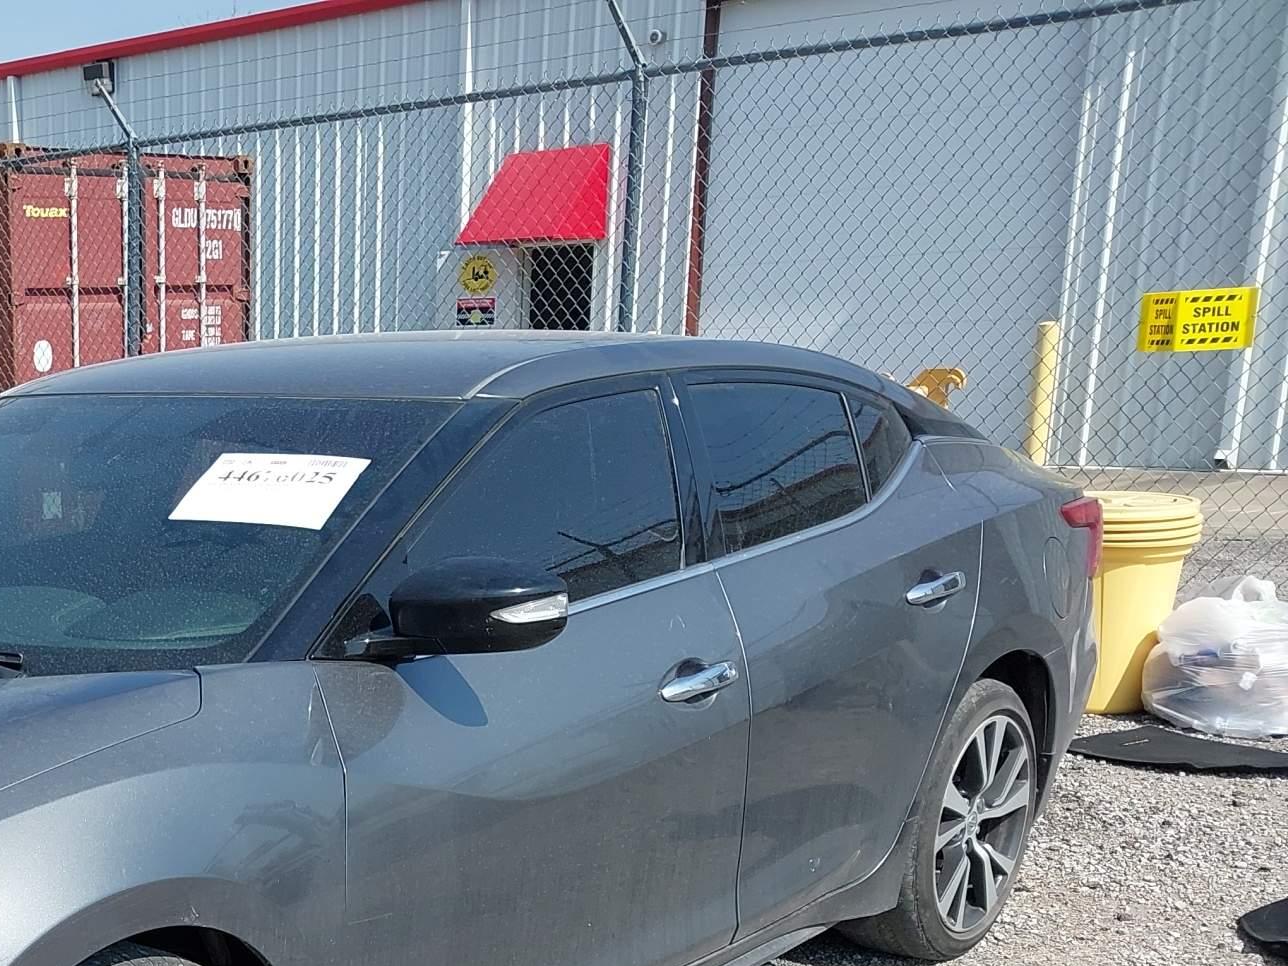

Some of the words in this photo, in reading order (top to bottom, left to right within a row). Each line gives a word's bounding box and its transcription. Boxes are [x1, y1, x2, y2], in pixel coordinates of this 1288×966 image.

[1155, 309, 1172, 320] SPILL
[1192, 306, 1232, 318] SPILL
[1149, 324, 1174, 336] STATION
[1182, 321, 1241, 334] STATION
